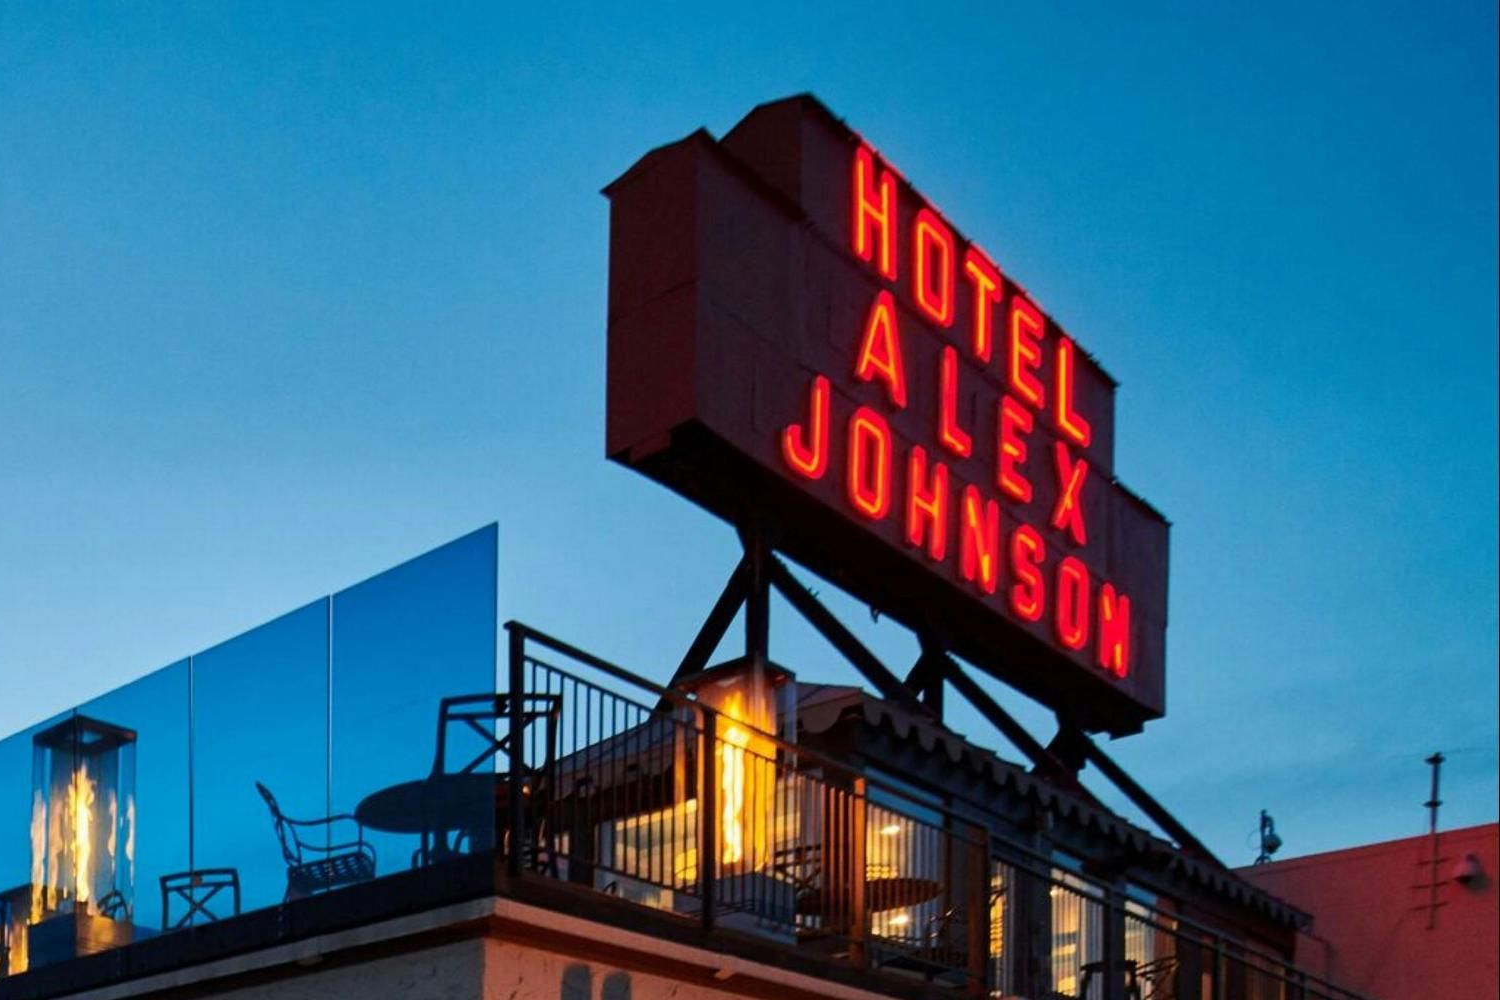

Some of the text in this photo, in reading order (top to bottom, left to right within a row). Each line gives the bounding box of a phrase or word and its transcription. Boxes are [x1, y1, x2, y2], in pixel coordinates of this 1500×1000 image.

[853, 144, 1090, 447] HOTEL
[857, 289, 1089, 545] ALEX
[784, 375, 1130, 678] JOHNSON
